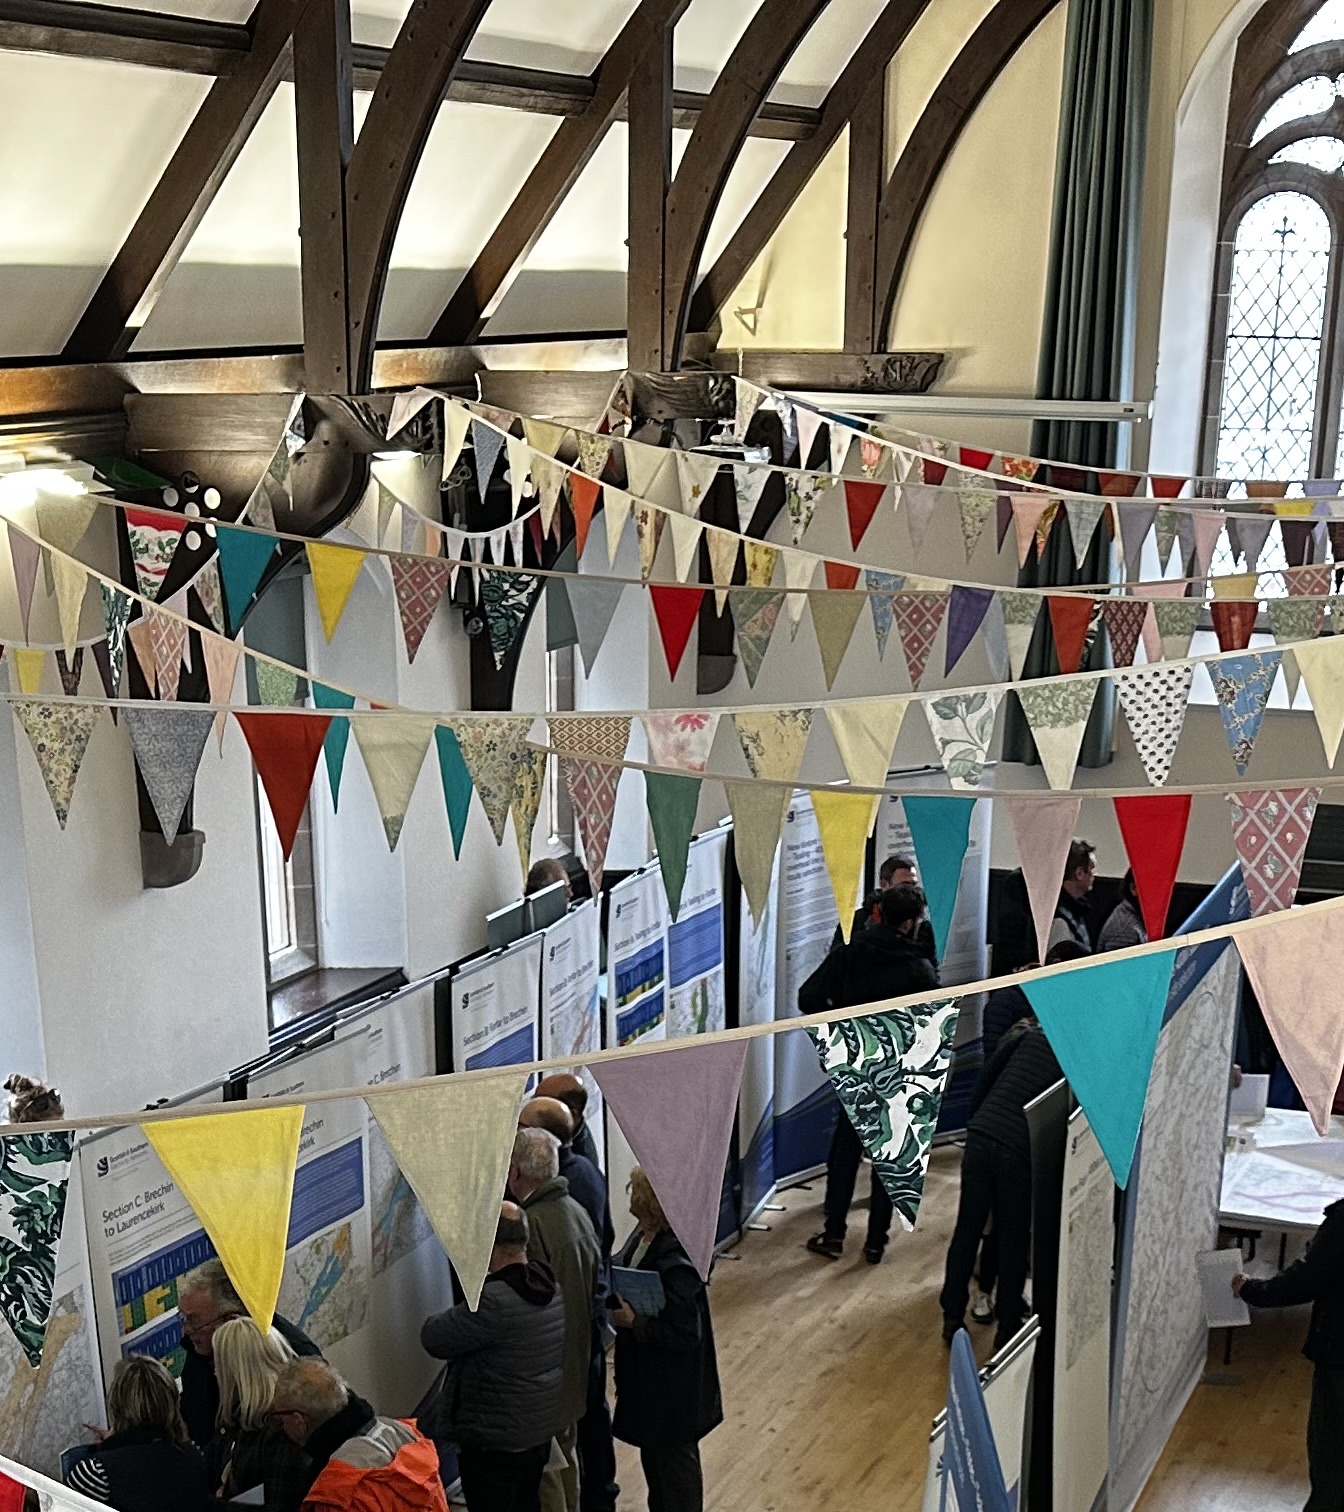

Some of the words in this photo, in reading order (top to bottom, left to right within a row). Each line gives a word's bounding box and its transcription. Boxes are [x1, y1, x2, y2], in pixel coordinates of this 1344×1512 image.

[102, 1203, 135, 1224] Section
[144, 1182, 175, 1203] Brechin
[104, 1226, 115, 1238] to
[116, 1200, 167, 1234] Laurencekirk
